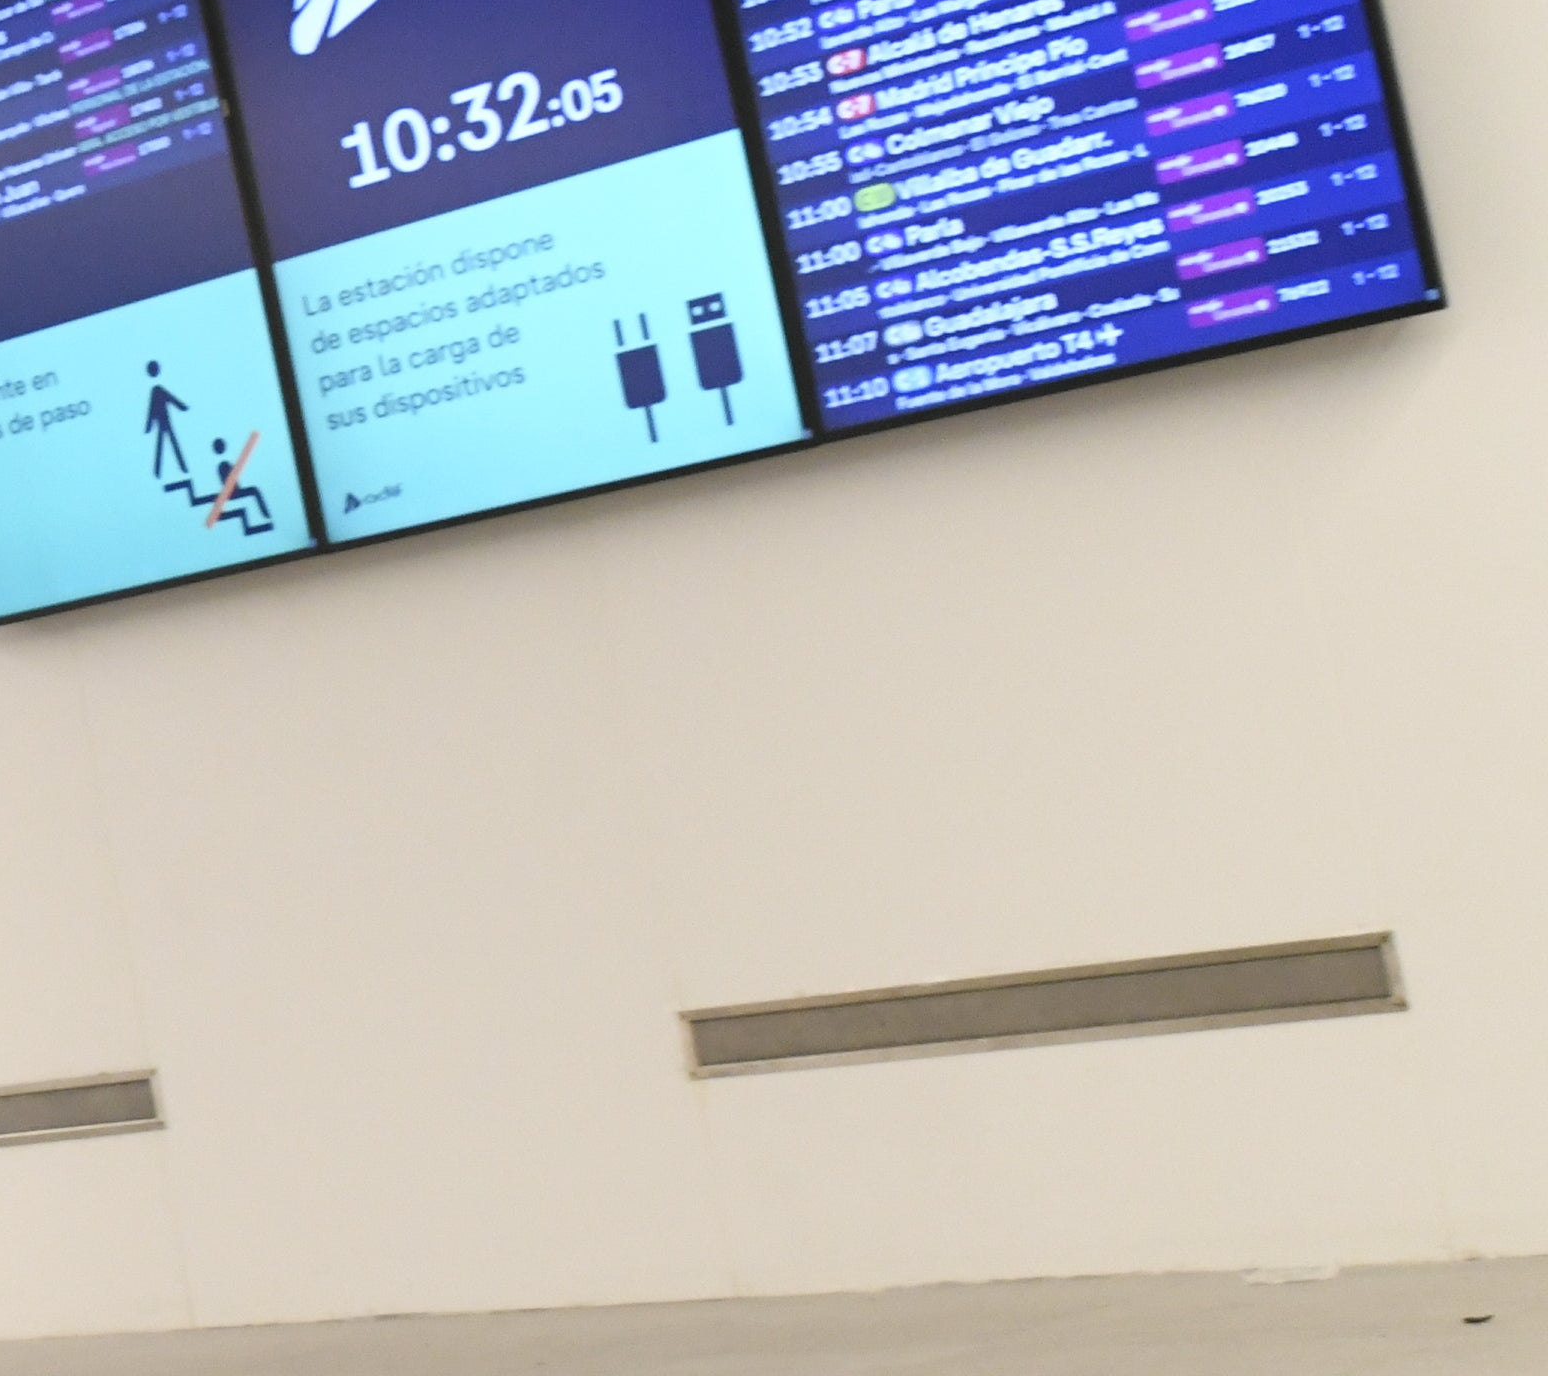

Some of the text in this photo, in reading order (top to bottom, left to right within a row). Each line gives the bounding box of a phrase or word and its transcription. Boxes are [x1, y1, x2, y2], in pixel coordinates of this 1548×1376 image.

[750, 17, 813, 52] 10:52
[759, 60, 823, 96] 10:53
[866, 27, 937, 64] Alcalá
[934, 21, 969, 44] de
[344, 71, 620, 186] 10:32:05
[769, 106, 833, 140] 10:54
[874, 71, 955, 109] Madrid
[778, 95, 1055, 185] 10:55 Colmenar Viejo
[787, 131, 1112, 229] 11:00 Villalba de Guadarr.
[301, 233, 553, 317] La estación dispone
[796, 217, 964, 274] 11:00 Parla
[806, 285, 871, 318] 11:05
[915, 218, 1163, 290] Alcobendas-S.S.Reyes
[309, 261, 605, 355] de espacios adaptados
[815, 330, 878, 363] 11:07
[923, 293, 1057, 336] Guadalajara
[31, 370, 57, 391] en
[317, 324, 520, 397] para la carga de
[825, 376, 889, 408] 11:10
[935, 341, 1061, 382] Aeropuerto
[1058, 329, 1095, 353] T4
[7, 413, 34, 435] de
[39, 399, 90, 430] paso
[325, 367, 524, 431] sus dispositivos
